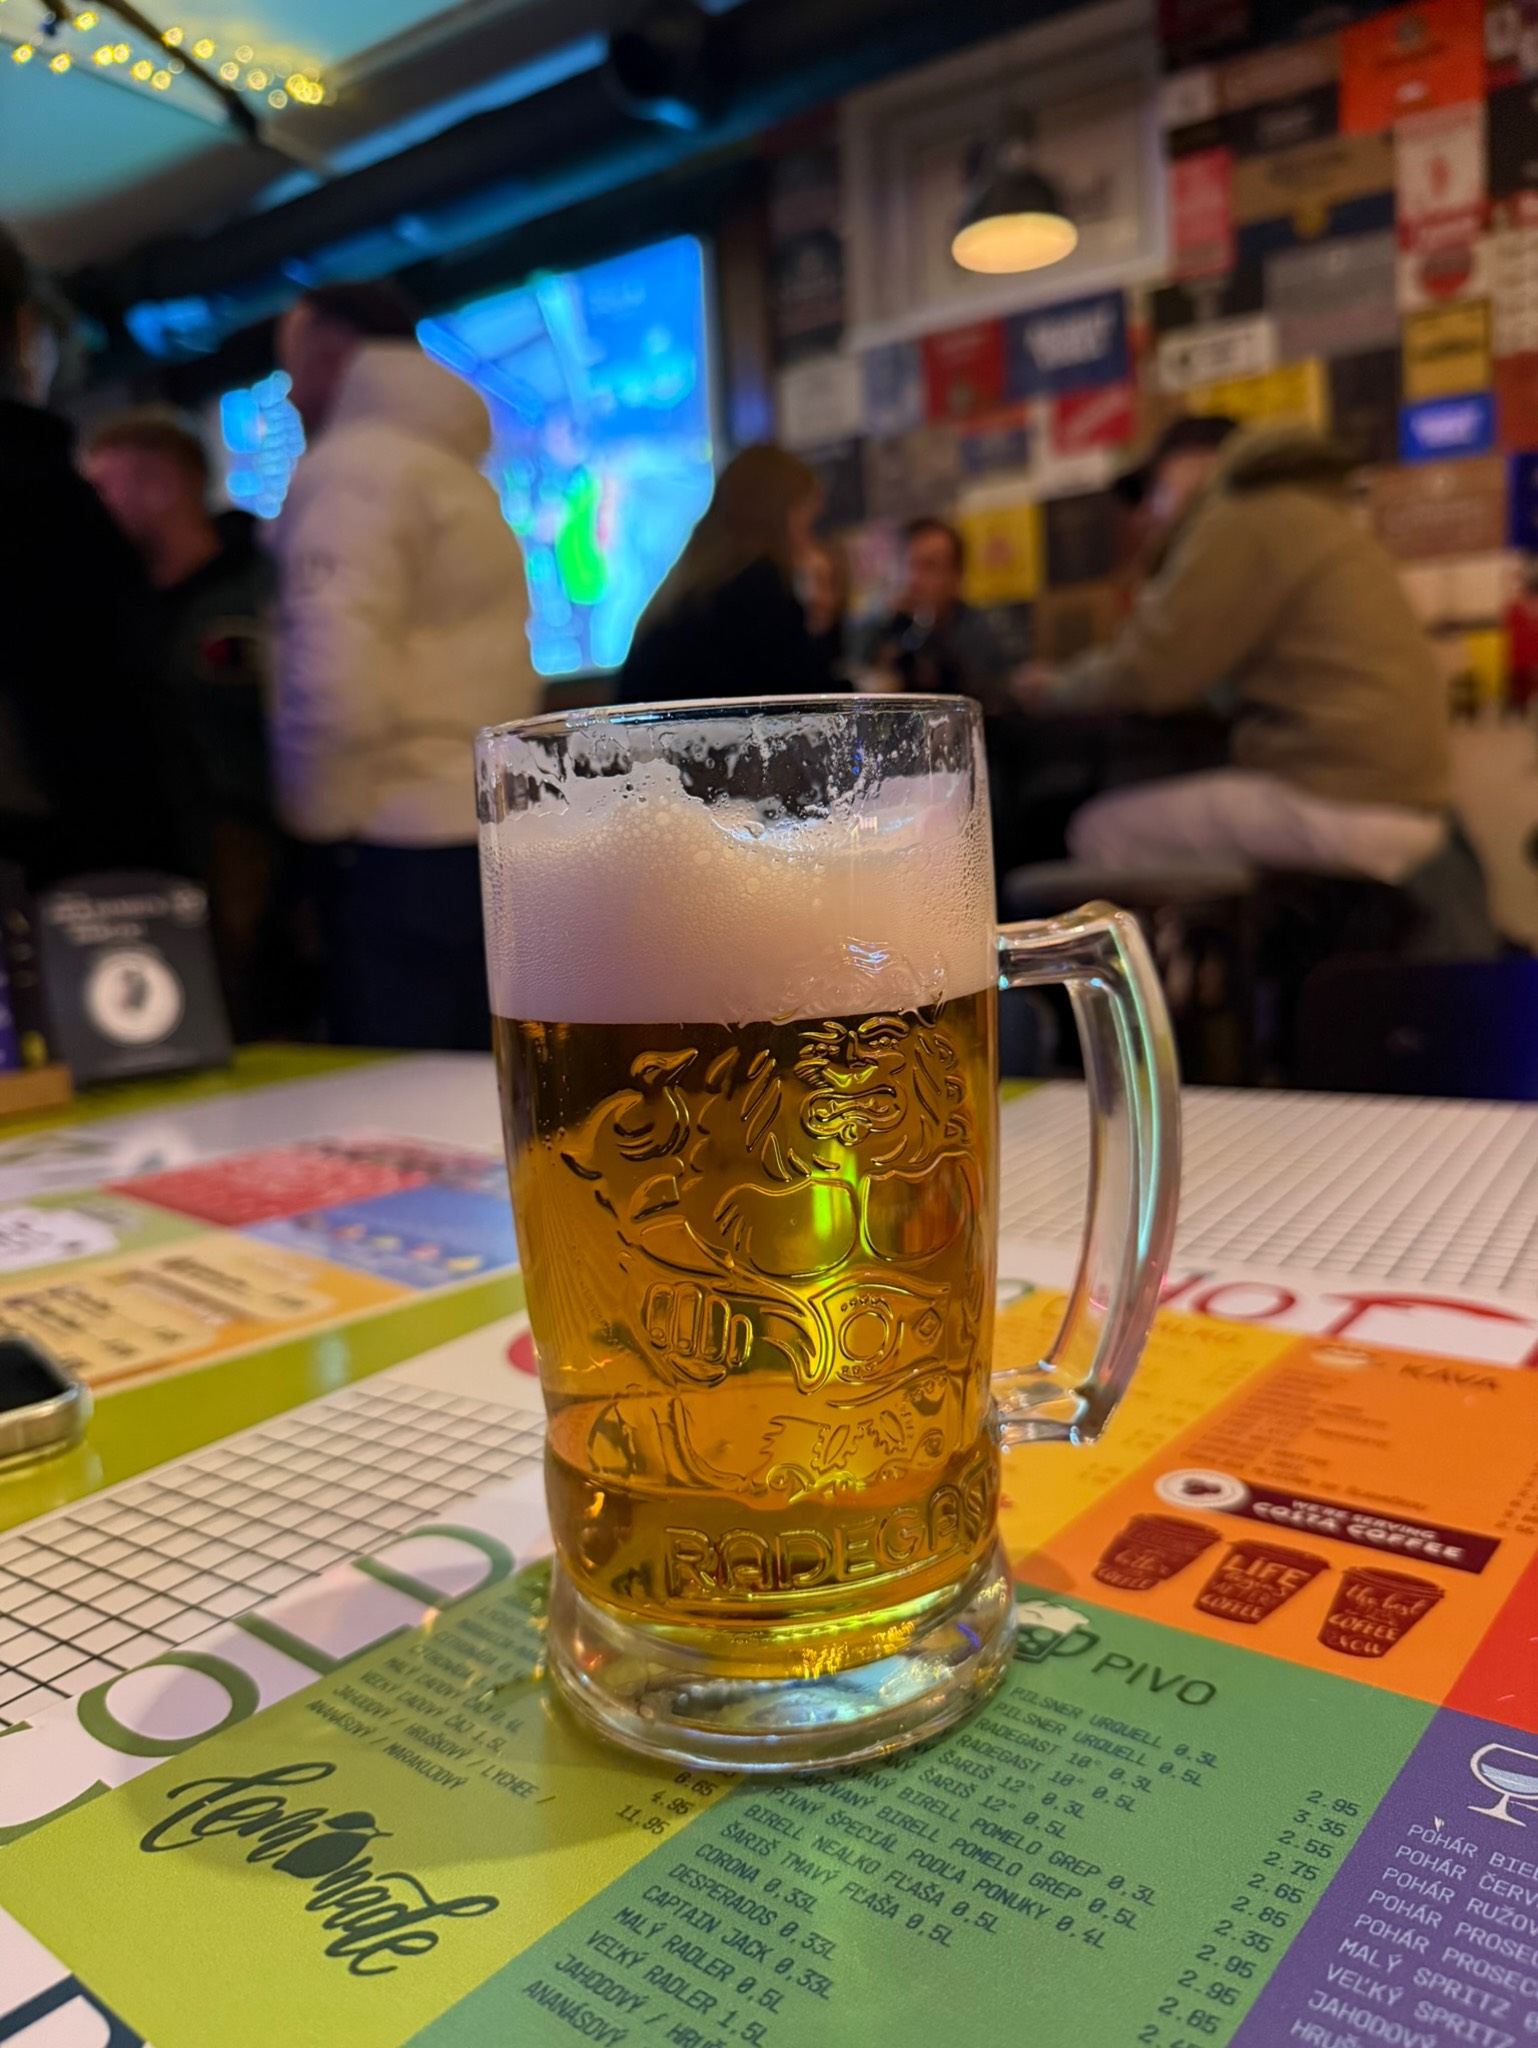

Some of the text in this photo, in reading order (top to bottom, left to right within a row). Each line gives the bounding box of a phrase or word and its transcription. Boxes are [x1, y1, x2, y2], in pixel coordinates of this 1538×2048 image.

[1252, 1501, 1465, 1561] COSTA COFFEE
[1200, 1593, 1264, 1619] COFFEE
[1328, 1613, 1401, 1641] COFFEE
[1091, 1652, 1217, 1706] PIVO
[975, 1717, 1062, 1755] RADEGAST
[993, 1702, 1067, 1735] PILSNER
[1072, 1730, 1147, 1766] URQUELL
[1010, 1687, 1083, 1719] PILSNER
[1089, 1714, 1162, 1749] URQUELL
[383, 1741, 469, 1791] MARAKUJOVÝ
[938, 1749, 996, 1780] ŠARIŠ
[956, 1735, 1045, 1773] RADEGAST
[481, 1764, 540, 1798] LYCHEE
[919, 1765, 978, 1798] ŠARIŠ
[616, 1804, 671, 1835] 11.95
[651, 1790, 695, 1816] 4.95
[1293, 1809, 1348, 1837] 3.35
[1306, 1790, 1361, 1817] 2.95
[897, 1787, 960, 1823] BIRELL
[970, 1817, 1043, 1856] POMELO
[1048, 1850, 1102, 1878] GREP
[1277, 1830, 1334, 1859] 2.55
[1407, 1824, 1479, 1859] POHÁR
[695, 1843, 760, 1883] CORONA
[720, 1820, 781, 1857] ŠARIŠ
[780, 1852, 841, 1885] TMAVÝ
[839, 1881, 900, 1919] FĽAŠA
[744, 1804, 805, 1841] BIRELL
[811, 1835, 882, 1874] NEALKO
[883, 1869, 945, 1907] FĽAŠA
[768, 1786, 825, 1815] PIVNÝ
[825, 1810, 899, 1854] ŠPECIÁL
[906, 1849, 967, 1885] PODĽA
[972, 1878, 1052, 1920] PONUKY
[876, 1805, 940, 1843] BIRELL
[949, 1837, 1024, 1877] POMELO
[1028, 1872, 1083, 1901] GREP
[1263, 1851, 1320, 1881] 2.75
[668, 1863, 778, 1926] DESPERADOS
[1247, 1873, 1306, 1904] 2.65
[1382, 1867, 1456, 1904] POHÁR
[1395, 1845, 1538, 1907] POHÁR ČERV
[642, 1885, 722, 1933] CAPTAIN
[721, 1928, 774, 1963] JACK
[1230, 1896, 1290, 1928] 2.85
[1368, 1889, 1443, 1929] POHÁR
[613, 1906, 667, 1939] MALÝ
[662, 1934, 736, 1982] RADLER
[1214, 1919, 1274, 1953] 2.35
[1354, 1914, 1538, 1998] POHÁR PROSEC
[586, 1930, 650, 1969] VEĽKÝ
[642, 1964, 718, 2015] RADLER
[1195, 1944, 1257, 1979] 2.95
[1338, 1938, 1512, 2020] MALÝ SPRITZ
[554, 1953, 650, 2013] JAHODOVÝ
[1177, 1970, 1240, 2006] 2.95
[522, 1979, 629, 2048] ANANÁSOVÝ
[1157, 1996, 1221, 2035] 2.65
[1308, 1990, 1438, 2048] JAHODOVÝ
[1327, 1963, 1404, 2007] VEĽKÝ
[1414, 2000, 1516, 2048] SPRITZ
